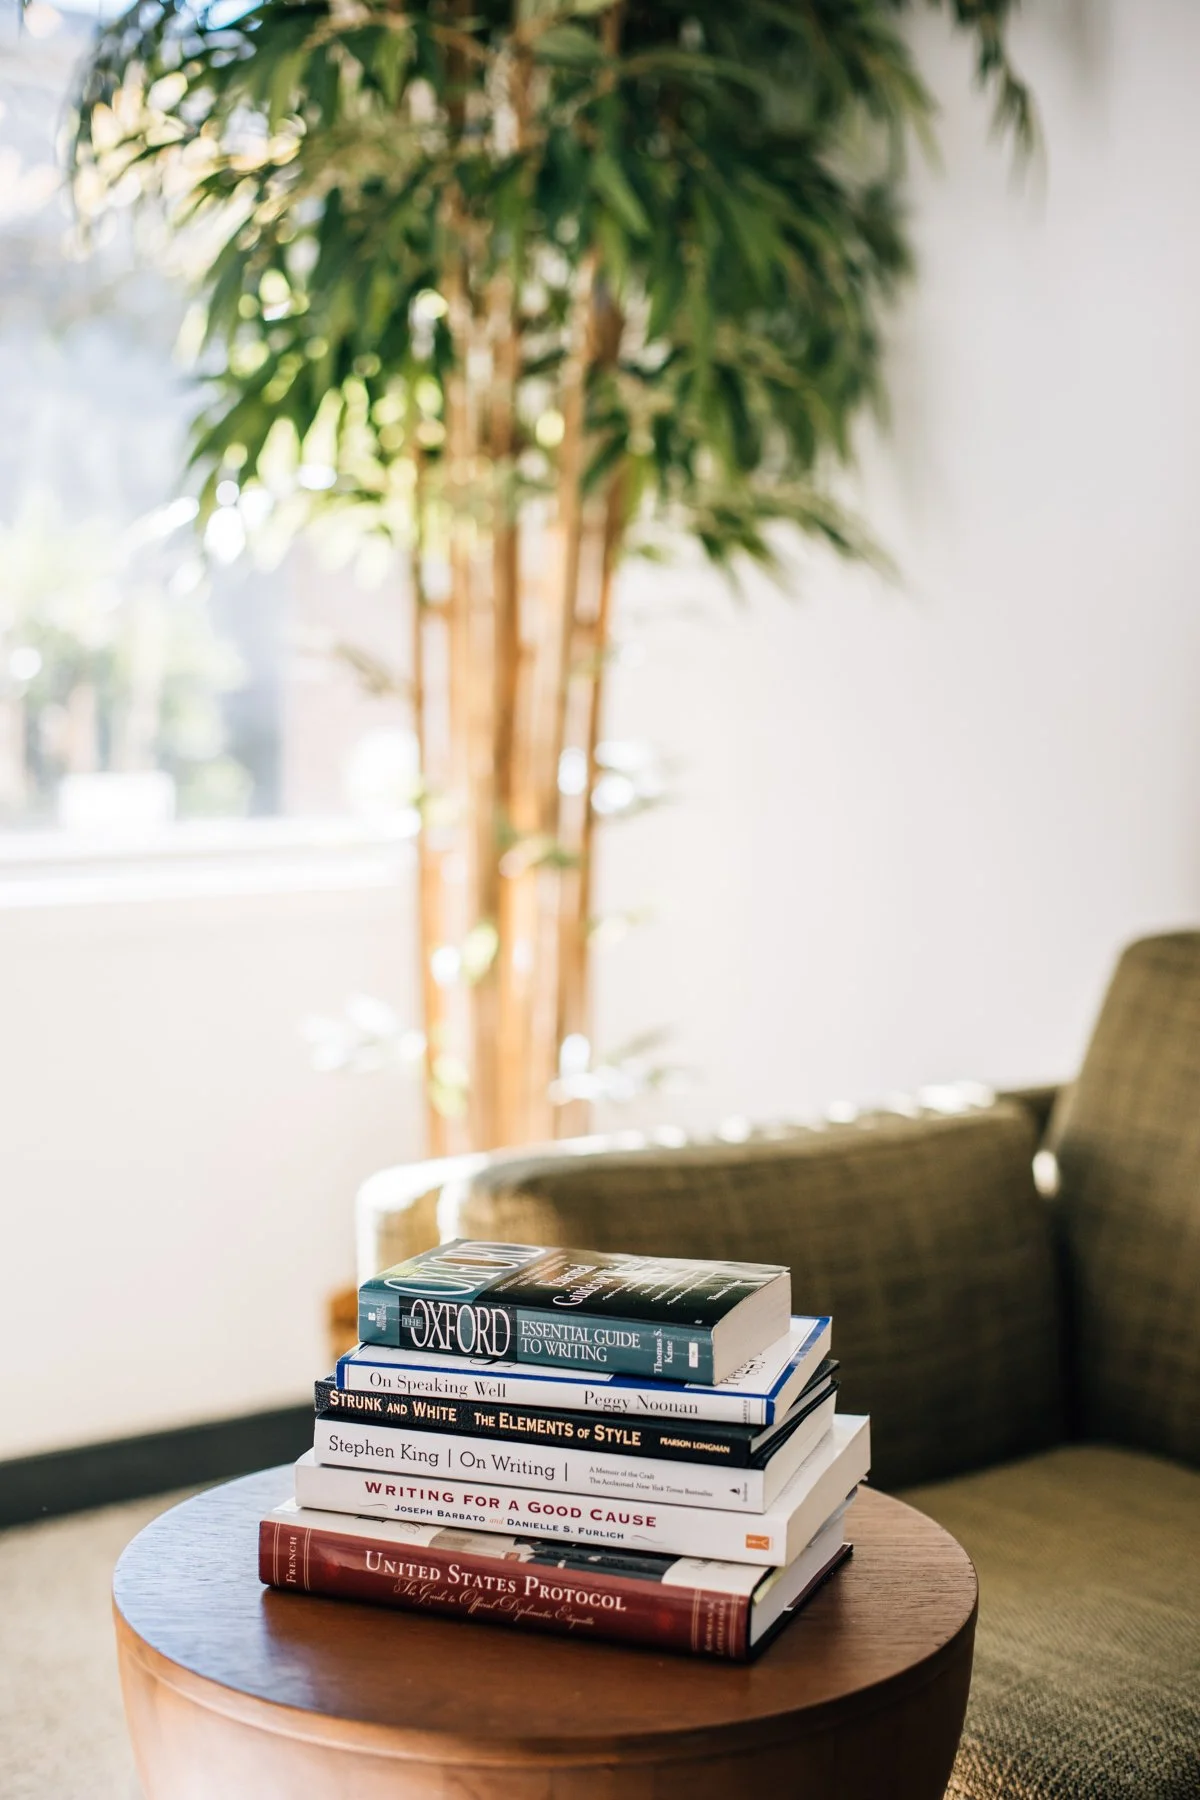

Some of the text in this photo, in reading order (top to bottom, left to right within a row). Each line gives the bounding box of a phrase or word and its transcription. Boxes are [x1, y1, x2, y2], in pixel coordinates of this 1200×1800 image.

[384, 1241, 546, 1295] OXFORD
[403, 1317, 423, 1328] THE
[410, 1298, 511, 1357] OXFORD
[521, 1320, 641, 1348] ESSENTIAL GUIDE
[521, 1337, 608, 1363] TO WRITING
[654, 1338, 663, 1374] Thomas
[664, 1340, 674, 1364] Kane
[369, 1371, 507, 1398] On Speaking Well
[584, 1390, 699, 1415] Peggy Noonan
[329, 1390, 731, 1454] STRUNK AND WHITE THE ELEMENTS OF STYLE PEARSON LONGMAN
[329, 1435, 556, 1481] Stephen King On Writing
[596, 1467, 620, 1476] Memoir
[639, 1472, 655, 1480] Craft
[364, 1481, 657, 1528] WRITING FOR A GOOD CAUSE
[394, 1504, 625, 1540] JOSEPH BARBATO and DANIELLE S. FURLICH
[286, 1536, 297, 1583] FRENCH
[365, 1550, 627, 1611] UNITED STATES PROTOCOL
[393, 1579, 416, 1596] The
[413, 1583, 449, 1605] Guide
[459, 1588, 500, 1614] Official
